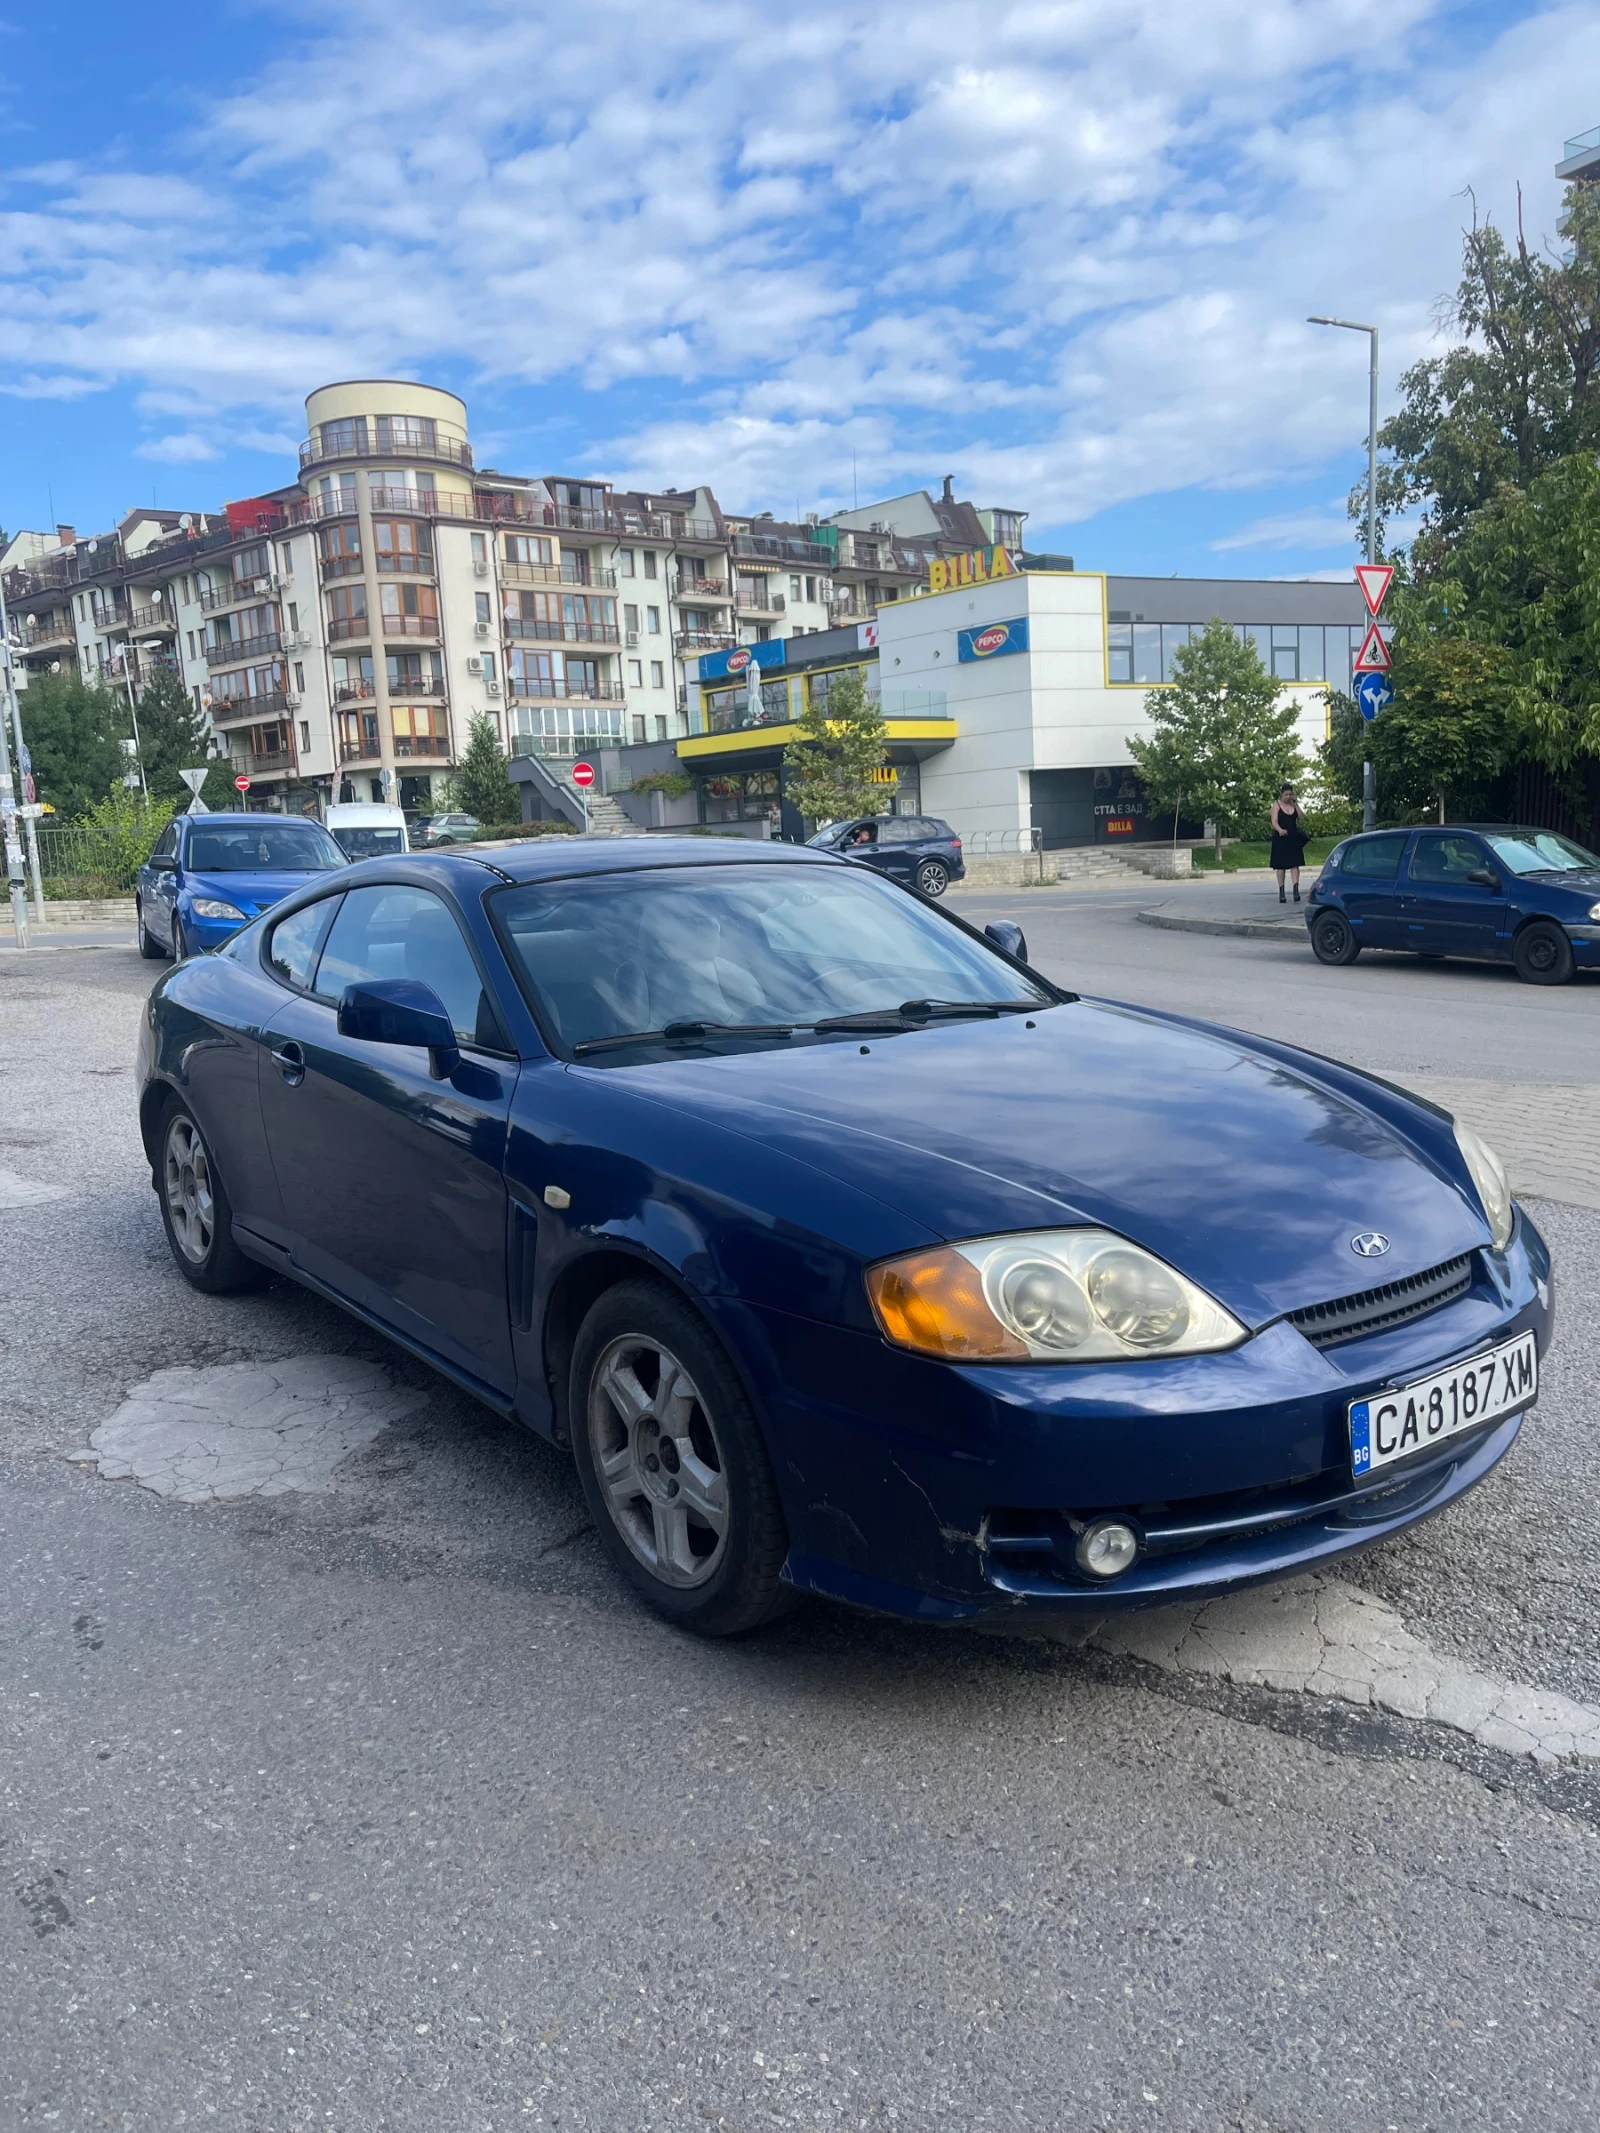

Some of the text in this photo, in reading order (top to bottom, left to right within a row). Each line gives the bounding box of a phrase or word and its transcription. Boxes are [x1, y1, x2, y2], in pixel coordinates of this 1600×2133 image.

[929, 545, 1011, 591] BILLA
[978, 633, 1004, 648] PEPCO
[730, 655, 748, 666] PEPCO
[1107, 821, 1133, 832] BILLA
[1354, 1446, 1369, 1465] BG
